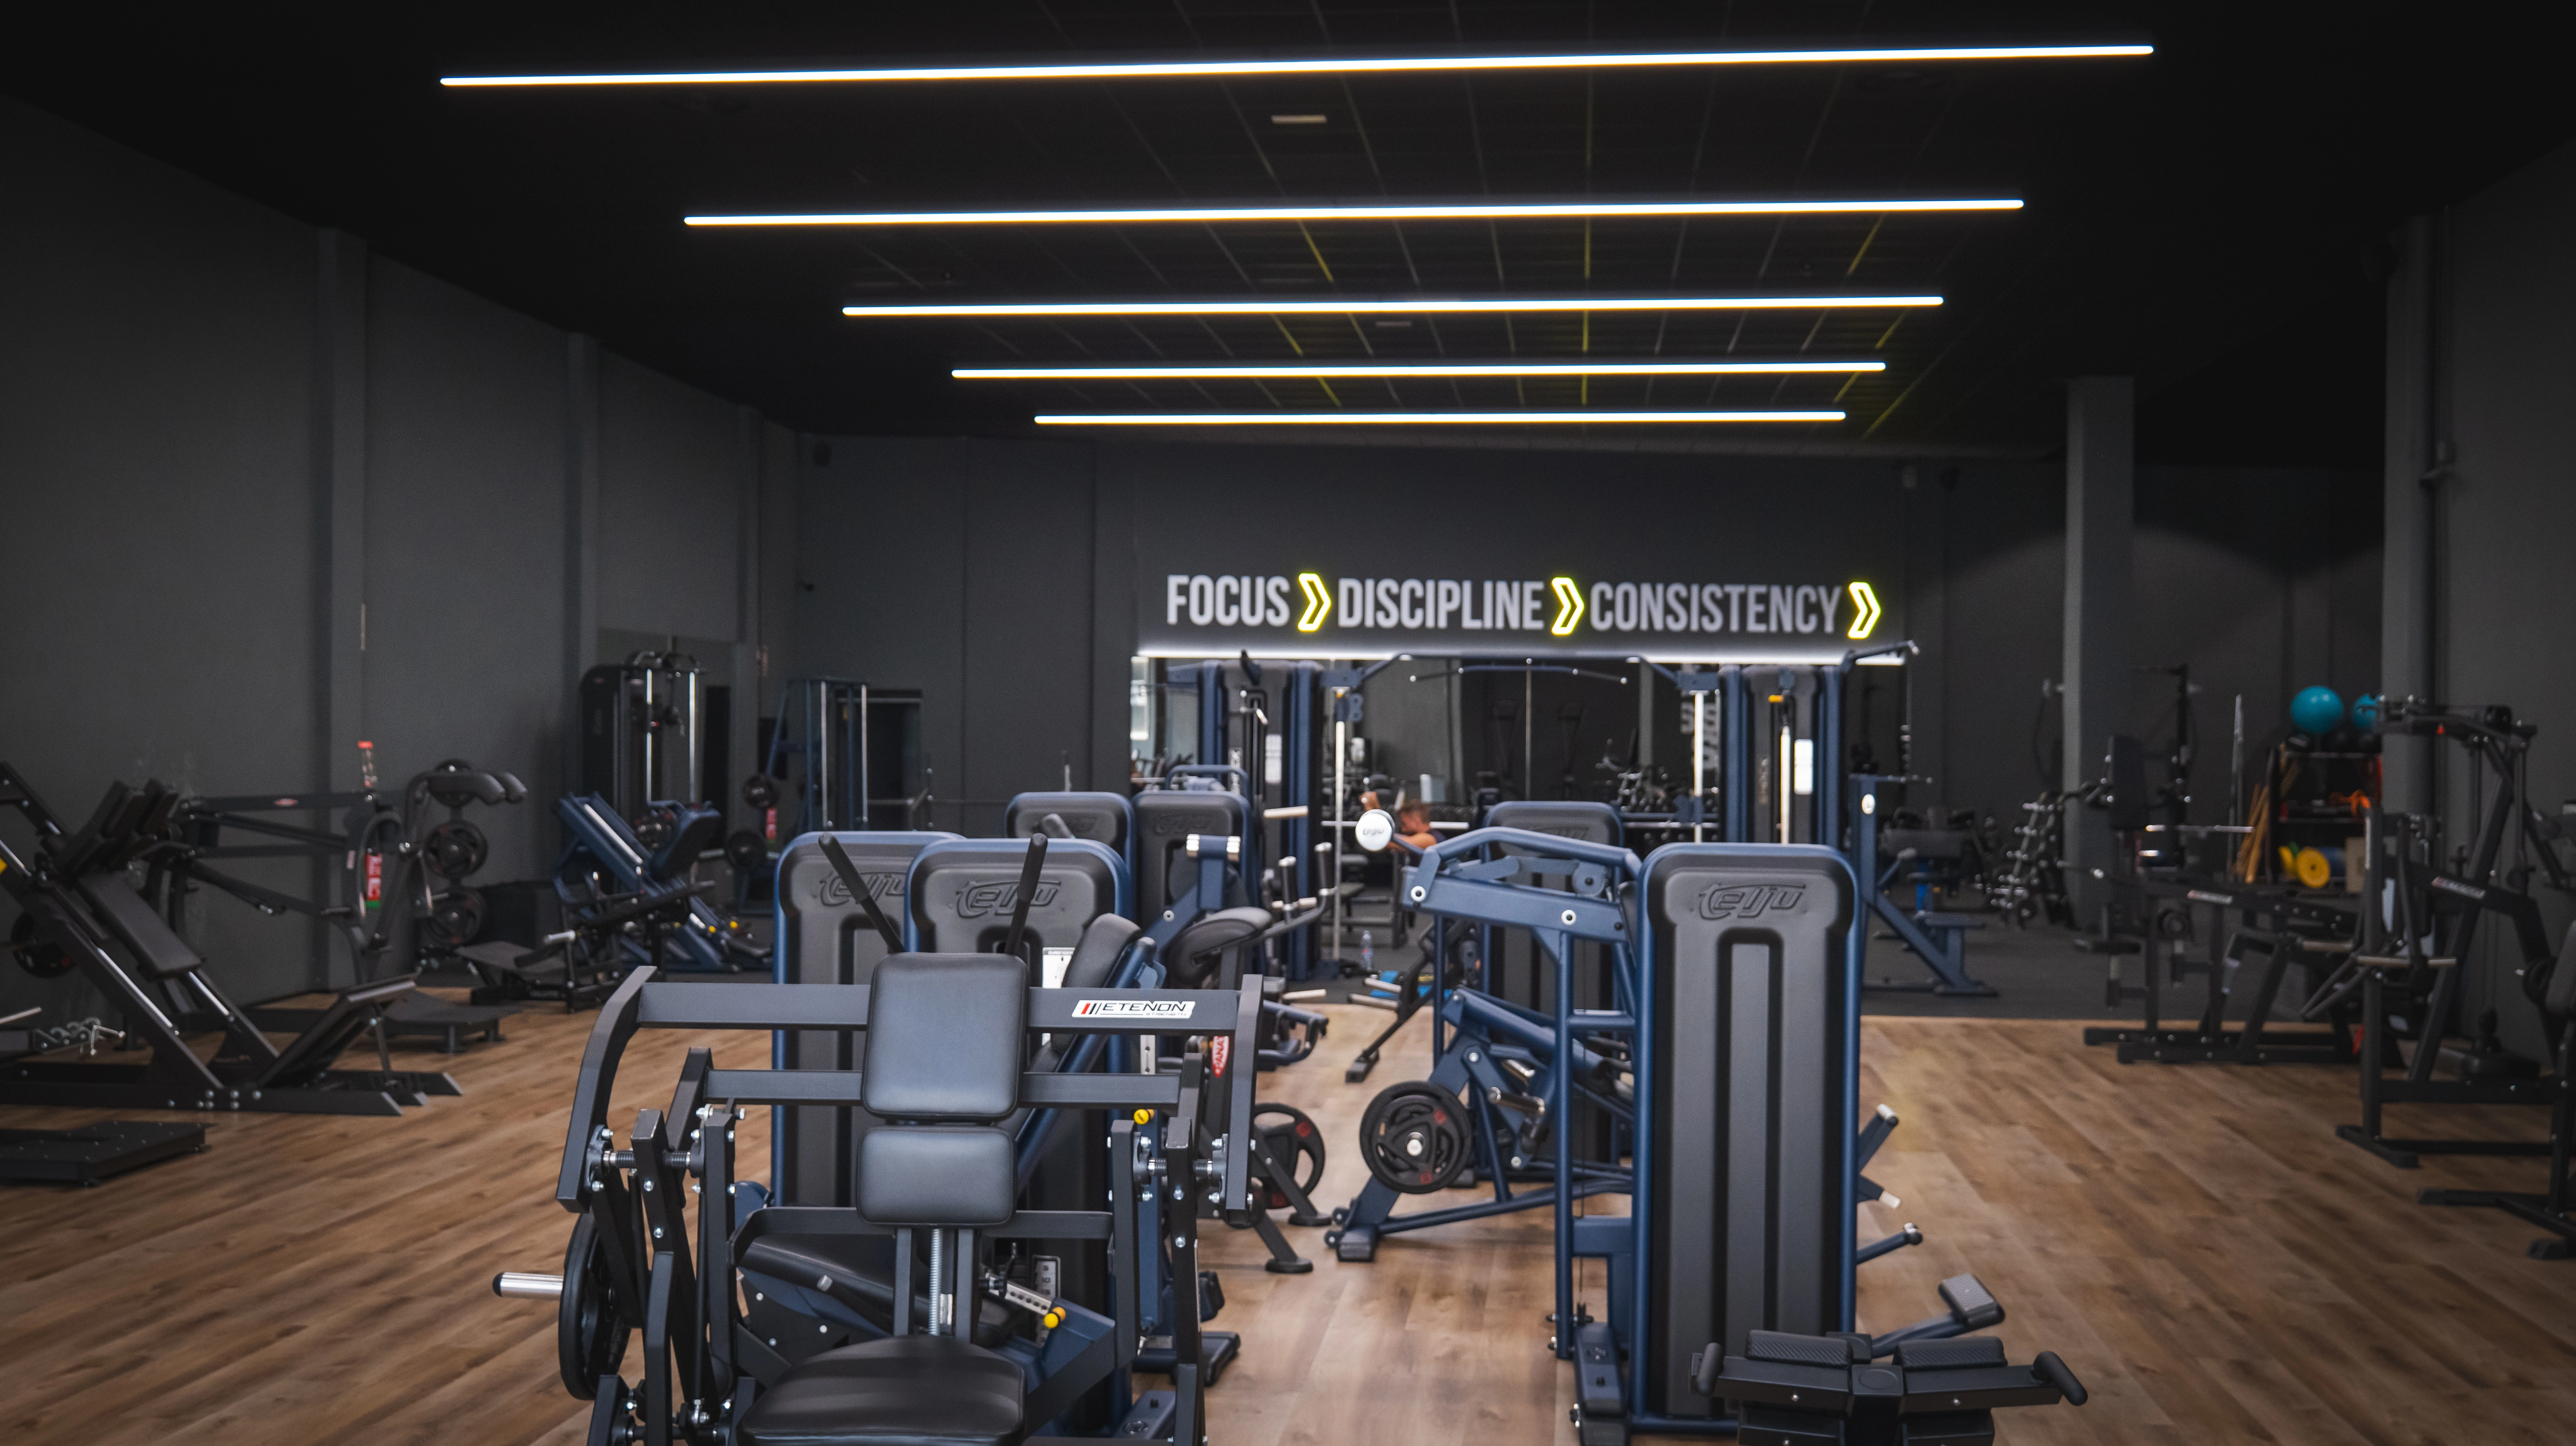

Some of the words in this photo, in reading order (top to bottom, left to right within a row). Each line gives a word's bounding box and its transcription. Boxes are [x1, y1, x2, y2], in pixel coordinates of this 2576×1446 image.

[1167, 574, 1290, 626] FOCUS
[1338, 578, 1544, 629] DISCIPLINE
[1590, 581, 1841, 633] CONSISTENCY
[1102, 1002, 1187, 1012] ETENON
